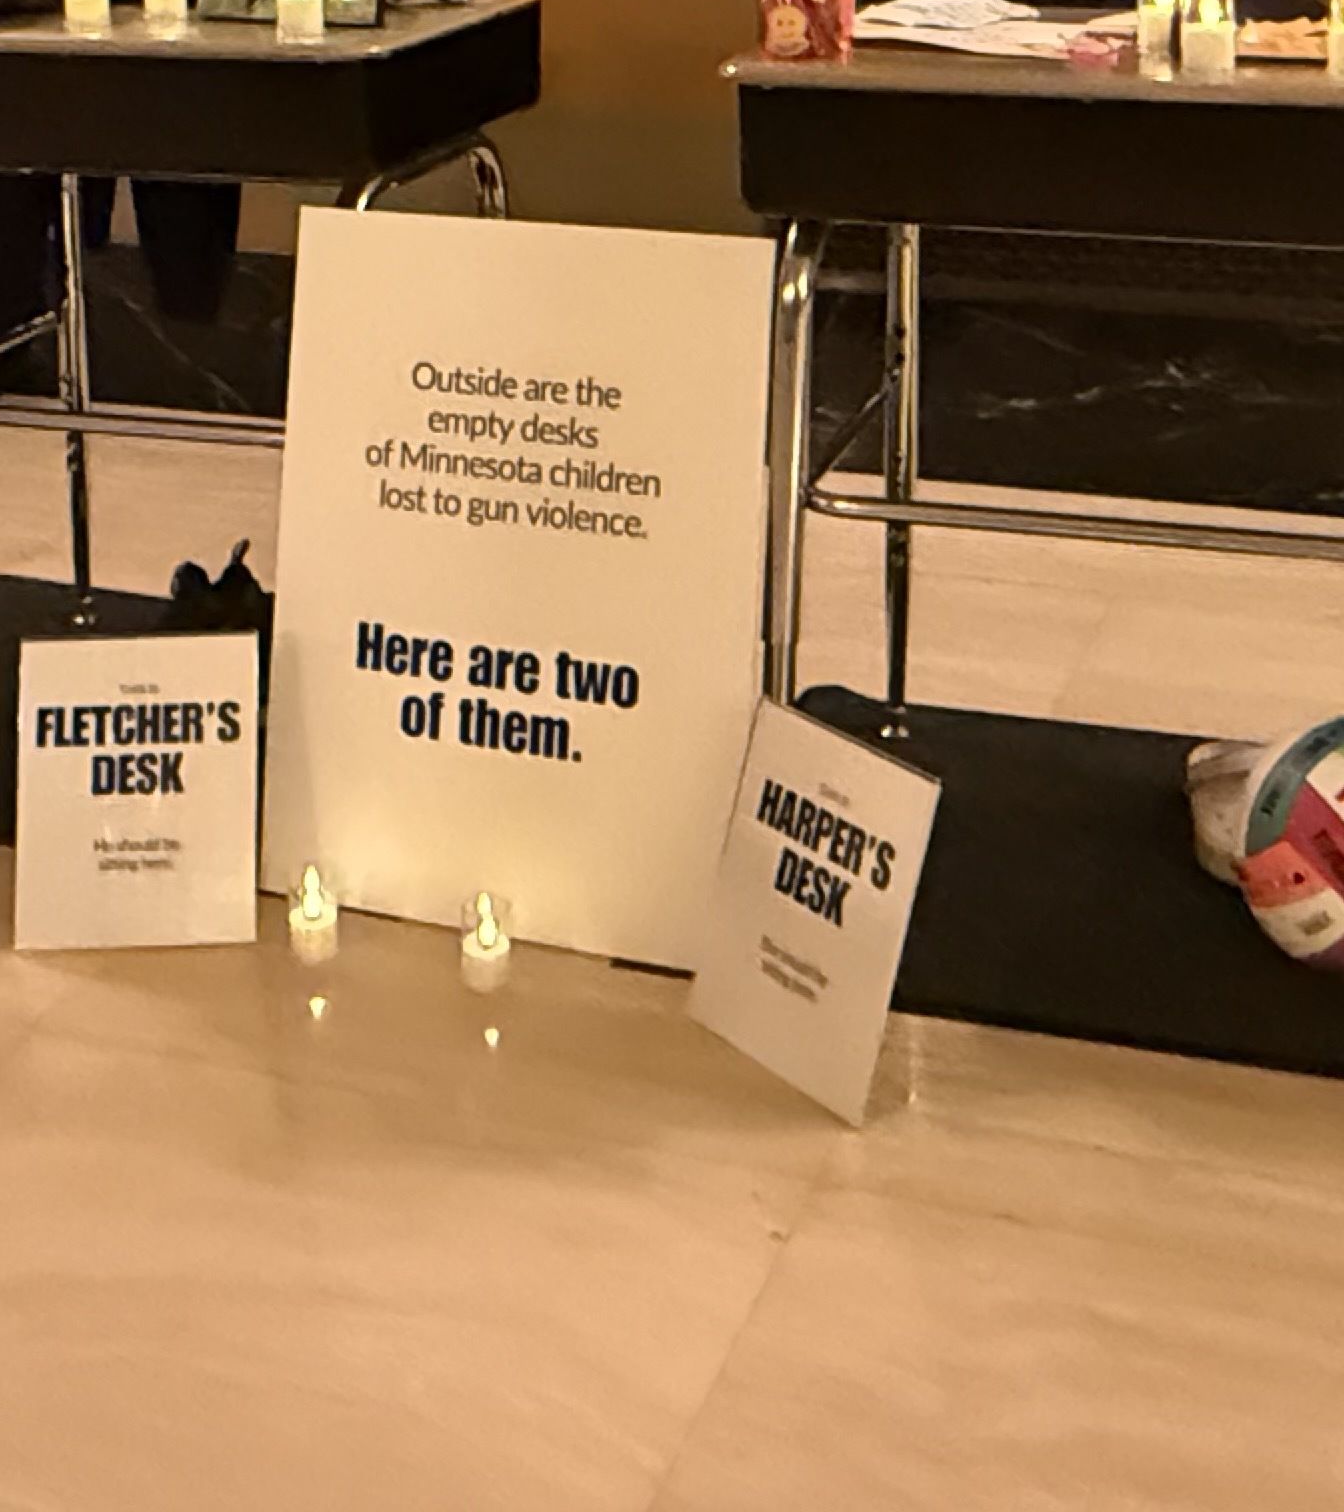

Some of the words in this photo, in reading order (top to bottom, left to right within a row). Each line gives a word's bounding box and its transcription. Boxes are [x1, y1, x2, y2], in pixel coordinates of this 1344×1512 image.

[410, 360, 519, 400] Outside
[522, 378, 570, 406] are
[574, 375, 623, 412] the
[427, 409, 516, 446] empty
[519, 411, 600, 450] desks
[364, 438, 396, 469] of
[399, 440, 543, 486] Minnesota
[548, 456, 662, 499] children
[378, 477, 428, 515] lost
[432, 487, 462, 518] to
[466, 496, 520, 528] gun
[525, 496, 649, 540] violence.
[355, 620, 454, 682] Here
[467, 644, 541, 695] are
[554, 650, 640, 710] two
[35, 700, 242, 748] FLETCHER'S
[400, 692, 445, 742] of
[458, 698, 582, 764] them.
[90, 751, 186, 797] DESK
[756, 777, 896, 892] HARPER'S
[773, 845, 852, 928] DESK
